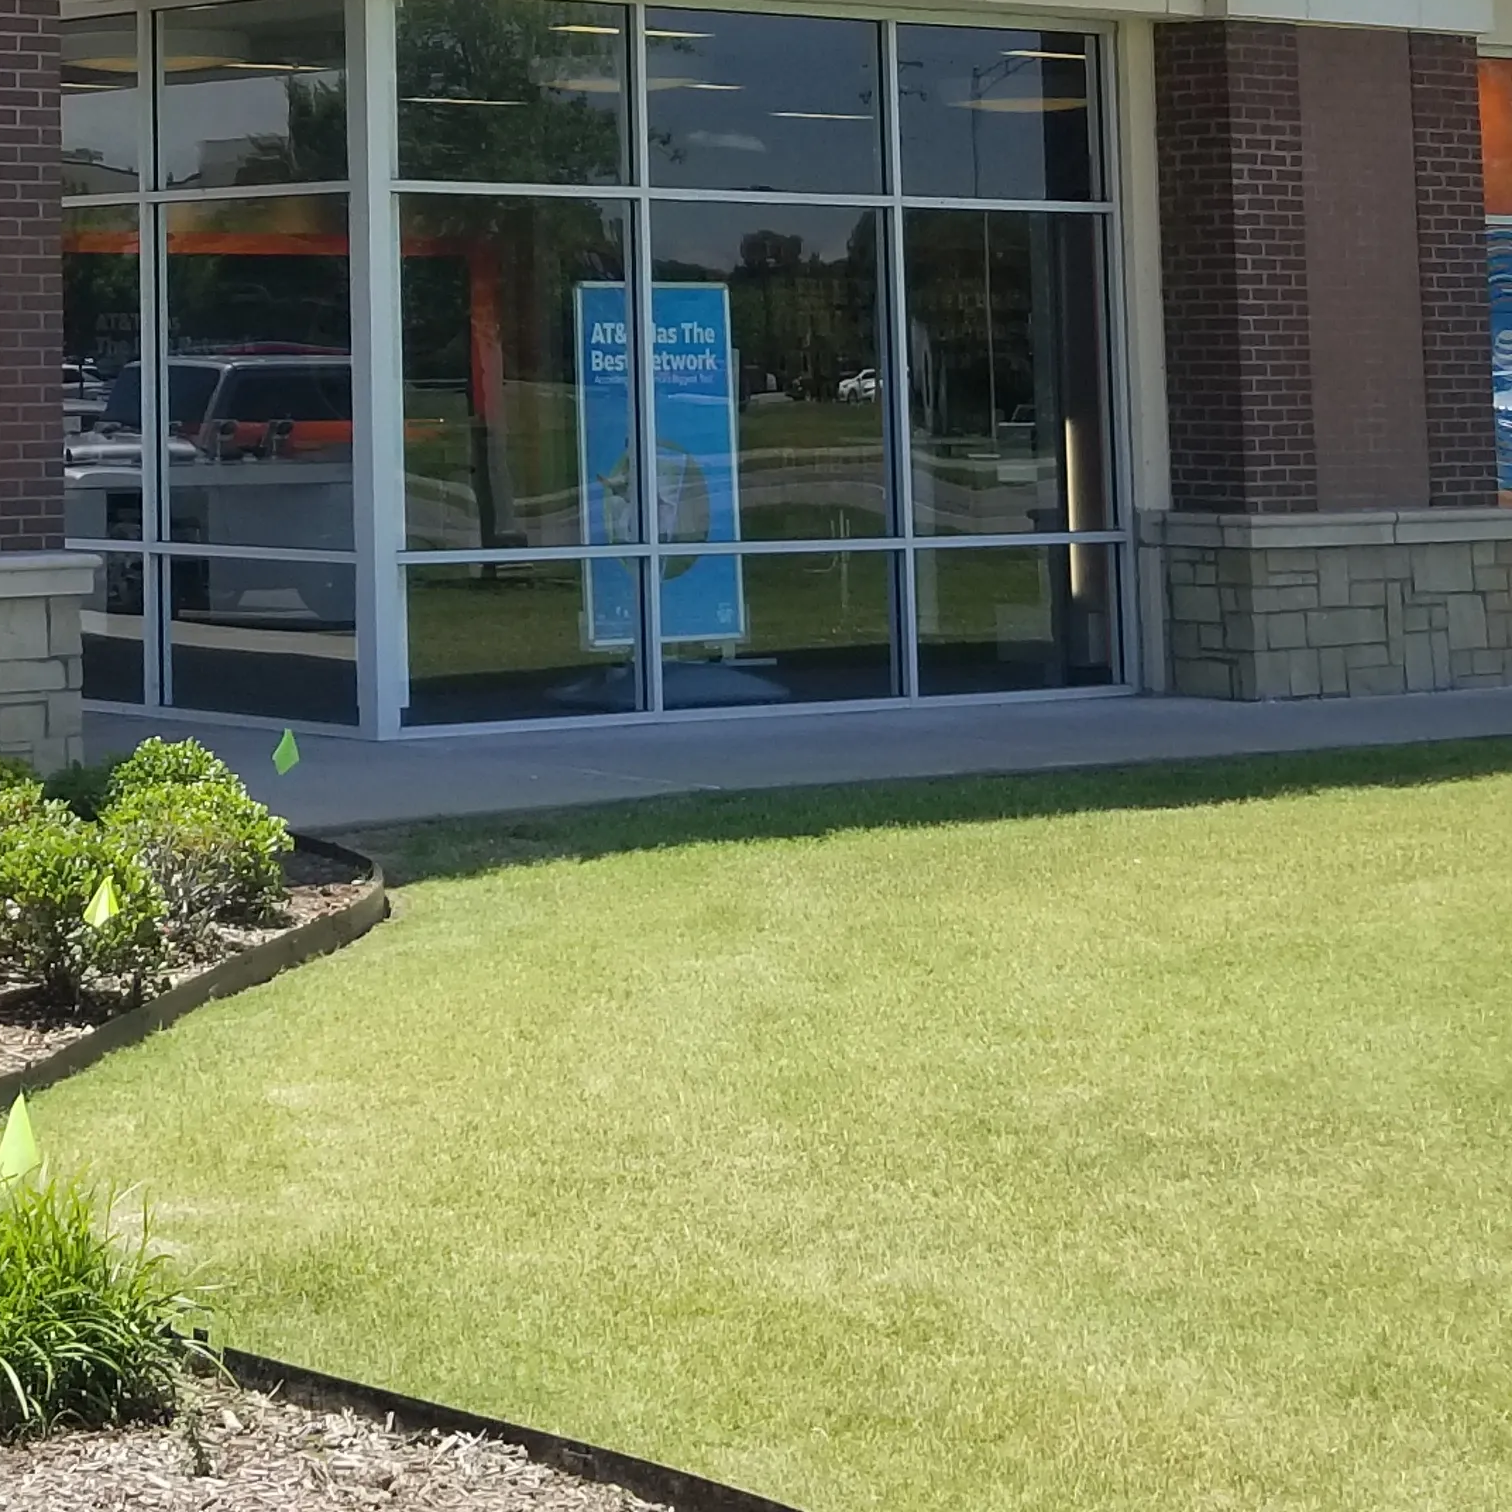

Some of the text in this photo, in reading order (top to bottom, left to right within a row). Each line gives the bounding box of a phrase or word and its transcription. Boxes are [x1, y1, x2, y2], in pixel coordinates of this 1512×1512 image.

[591, 322, 627, 344] AT&
[680, 321, 715, 344] The
[652, 348, 717, 371] etwork
